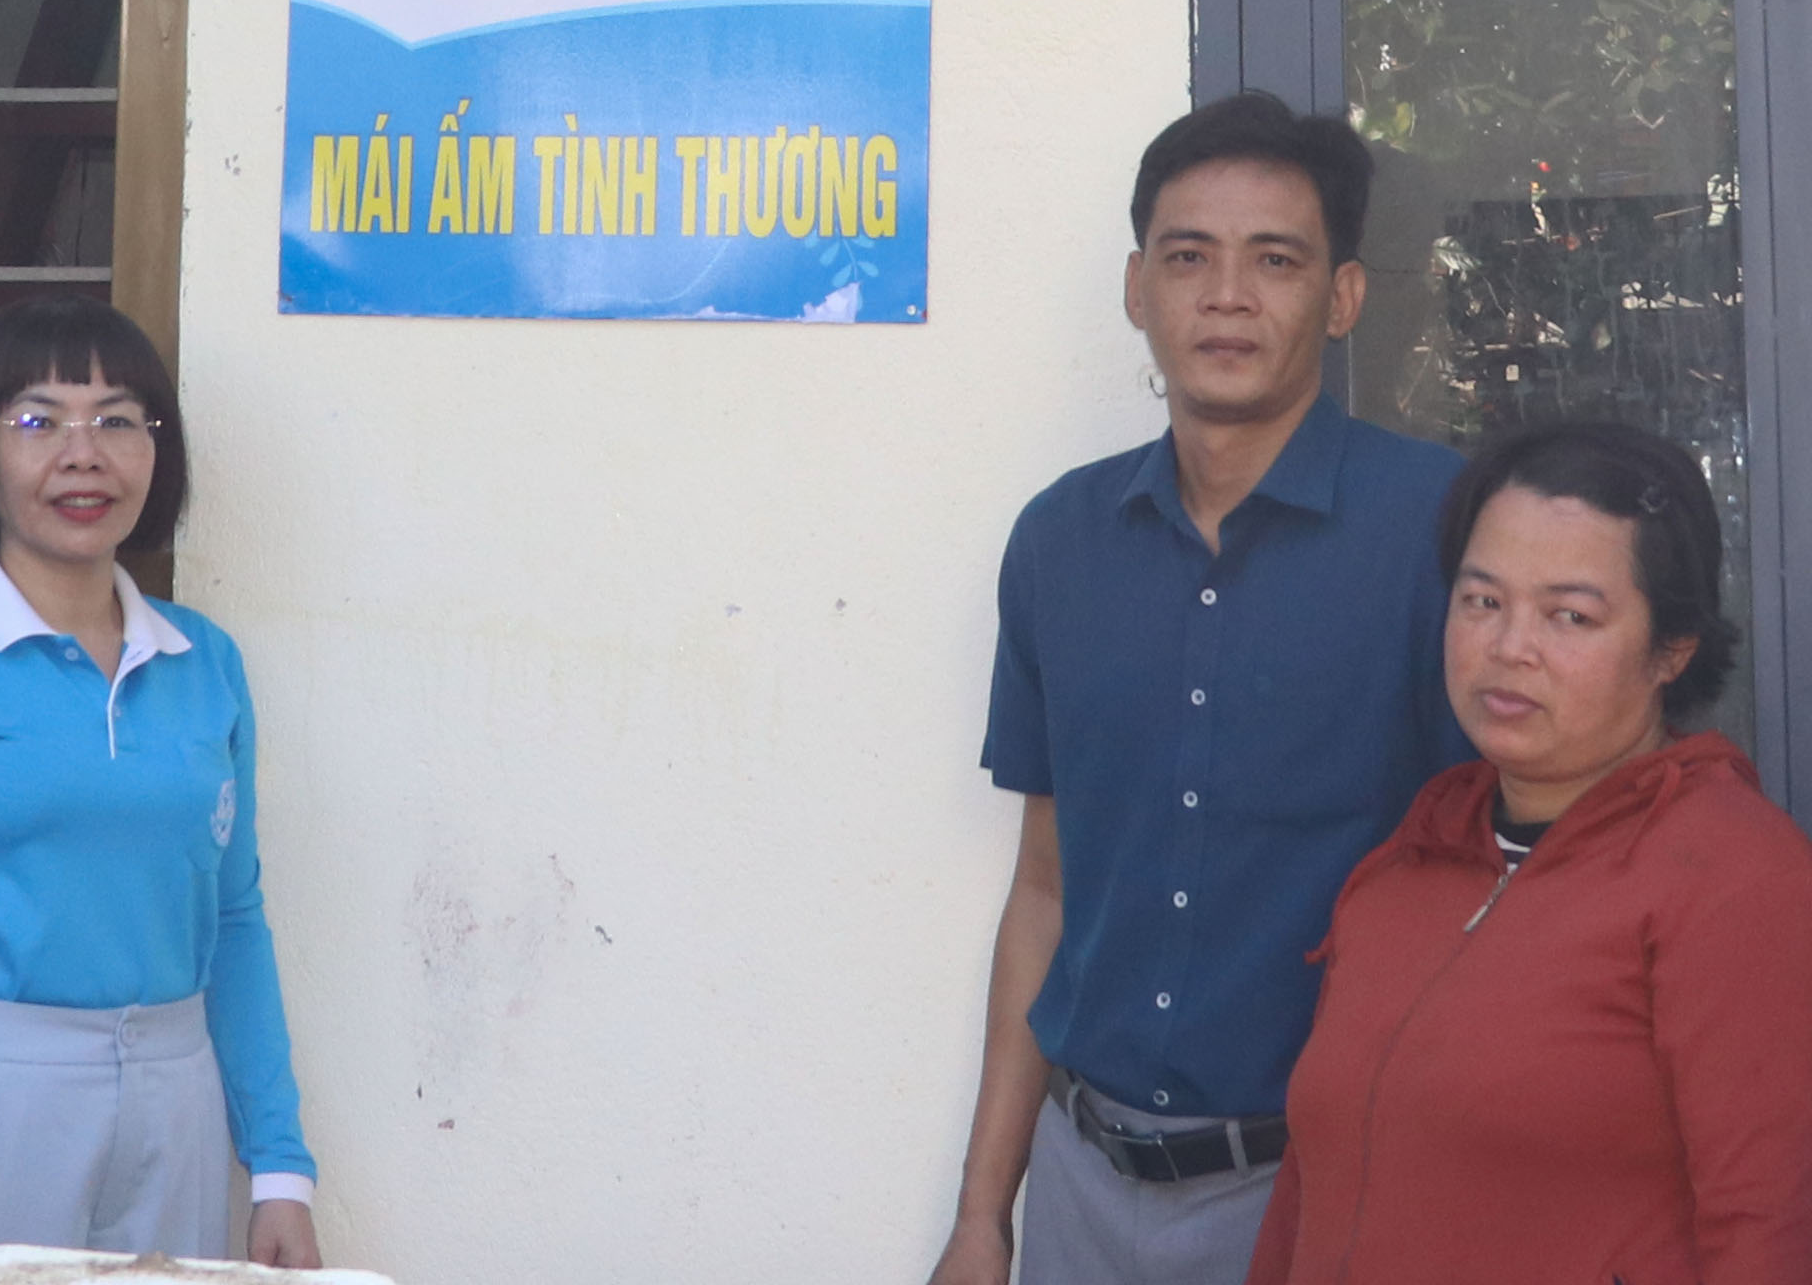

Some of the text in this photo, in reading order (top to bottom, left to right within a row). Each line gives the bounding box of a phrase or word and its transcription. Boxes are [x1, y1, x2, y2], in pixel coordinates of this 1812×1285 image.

[309, 97, 898, 238] MÁI ẤM TÌNH THƯƠNG
